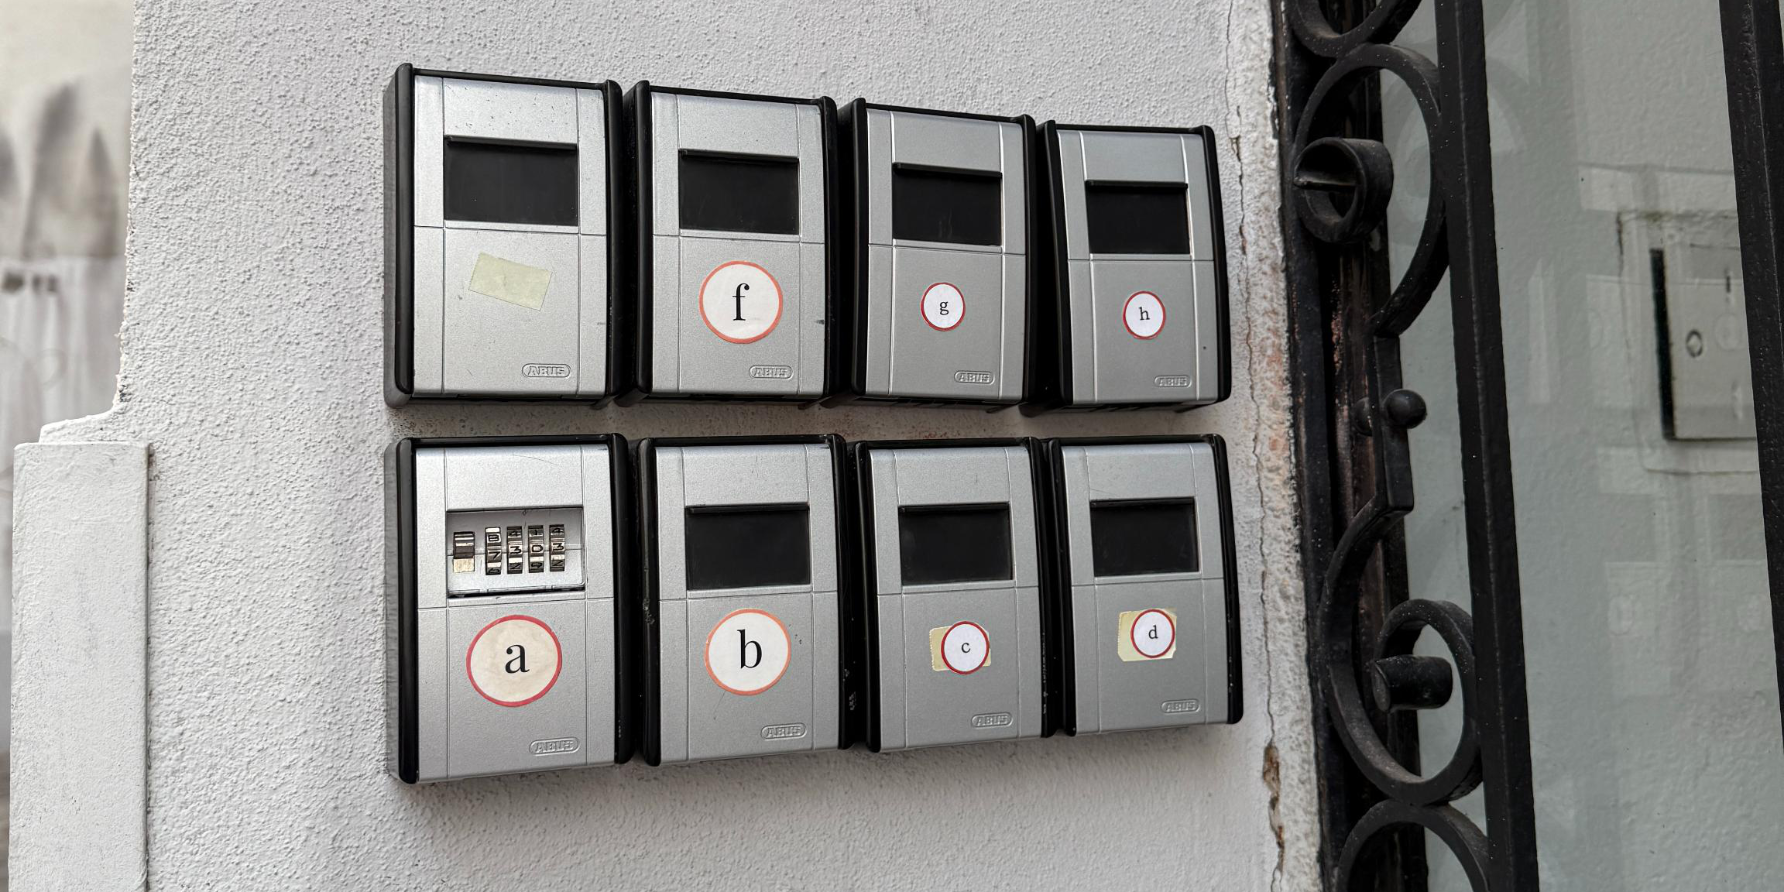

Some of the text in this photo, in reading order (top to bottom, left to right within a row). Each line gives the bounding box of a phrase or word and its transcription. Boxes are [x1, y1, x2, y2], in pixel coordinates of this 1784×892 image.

[732, 282, 750, 321] f
[939, 301, 950, 316] g
[1138, 306, 1151, 321] h
[527, 365, 566, 377] ABUS
[752, 367, 789, 379] ABUS
[959, 372, 991, 383] ABUS
[1148, 624, 1159, 640] d
[736, 628, 763, 669] b
[961, 642, 971, 654] c
[504, 644, 530, 674] a
[765, 725, 802, 738] ABUS
[534, 739, 575, 753] ABUS
